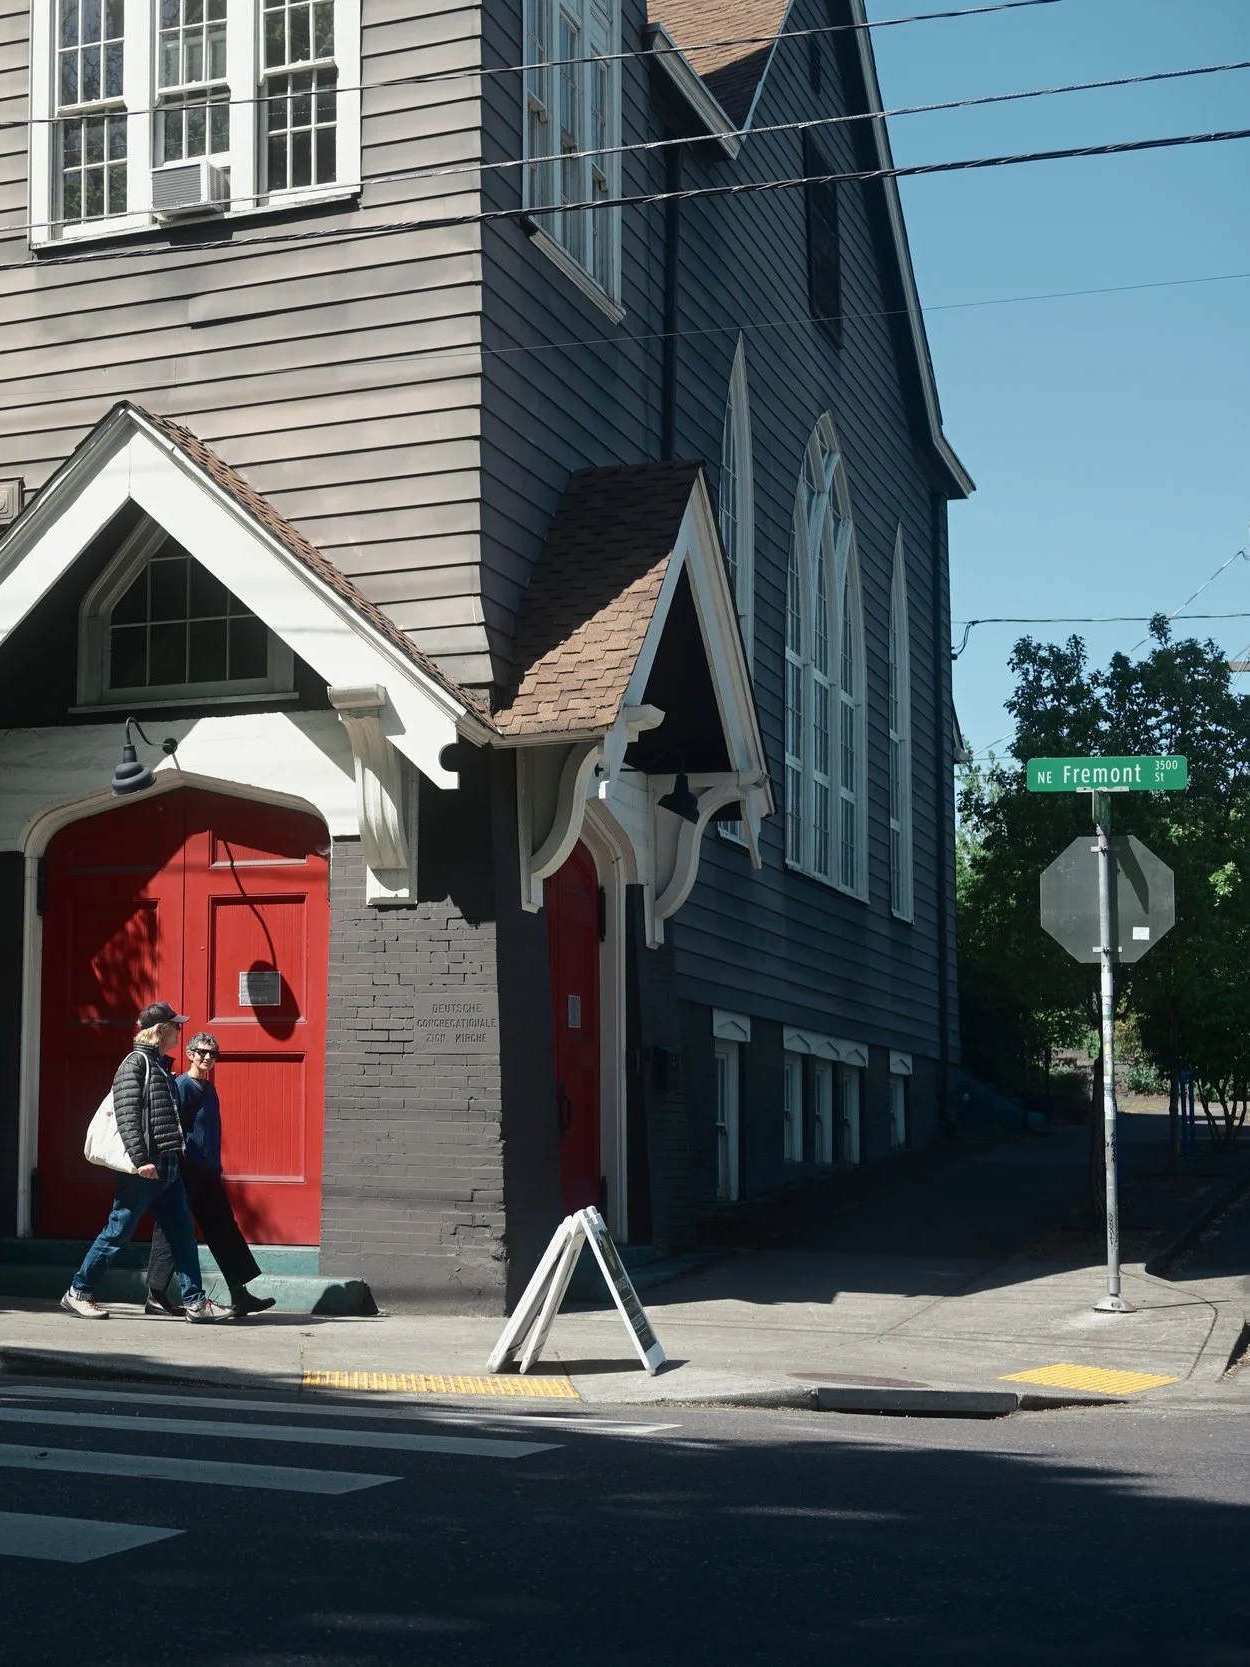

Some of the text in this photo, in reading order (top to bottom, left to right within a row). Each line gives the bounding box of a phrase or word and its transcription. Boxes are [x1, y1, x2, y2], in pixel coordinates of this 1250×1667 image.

[1154, 759, 1178, 771] 3500
[1037, 764, 1141, 784] NE Fremont
[1154, 771, 1165, 782] St
[432, 1003, 483, 1013] DEUTSCHE
[455, 1033, 487, 1043] KIRCHE
